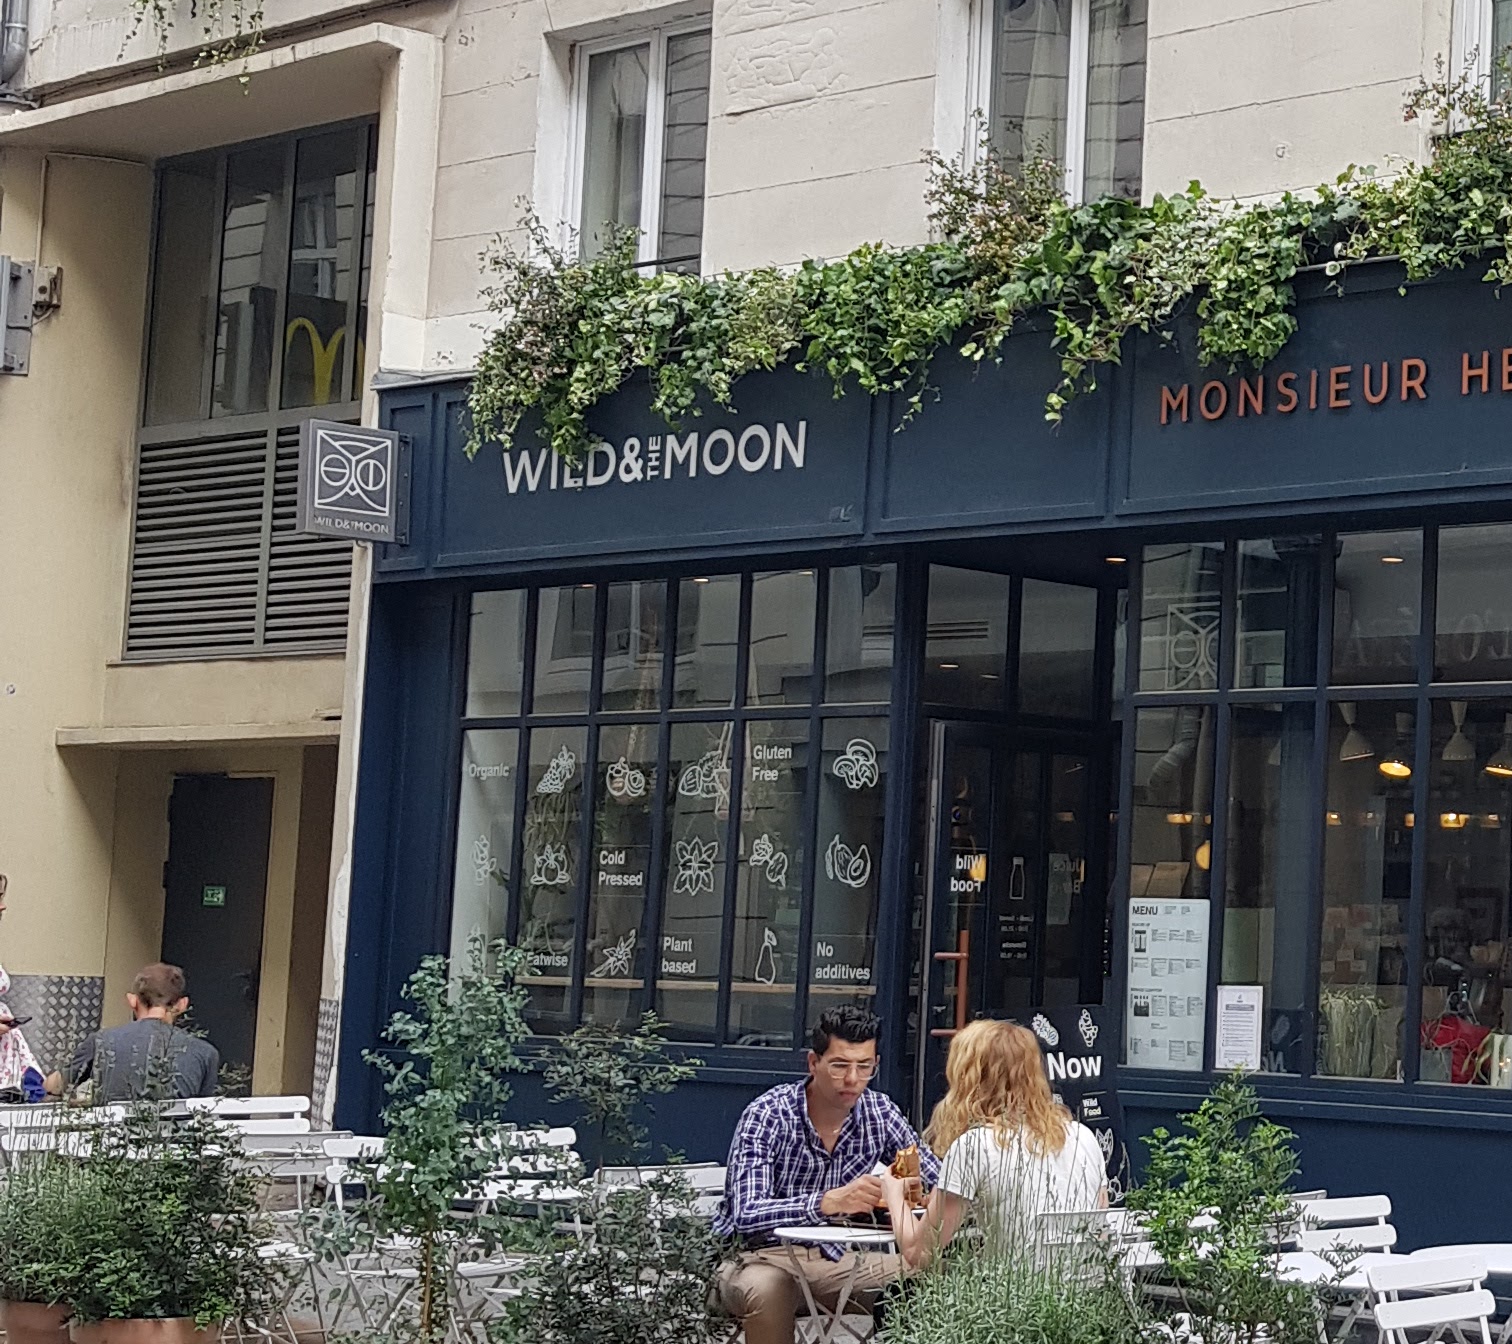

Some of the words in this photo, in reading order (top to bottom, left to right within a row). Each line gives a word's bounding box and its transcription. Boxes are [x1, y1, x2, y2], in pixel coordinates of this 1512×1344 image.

[1160, 357, 1429, 425] MONSIEUR
[752, 744, 792, 762] Gluten
[468, 762, 510, 782] Organic
[751, 766, 779, 782] Free
[599, 850, 625, 865] Cold
[598, 871, 643, 887] Pressed
[1132, 905, 1159, 915] MENU
[663, 937, 693, 954] Plant
[816, 941, 834, 958] No
[660, 957, 697, 975] based
[814, 963, 871, 981] additives
[1046, 1051, 1102, 1081] Now
